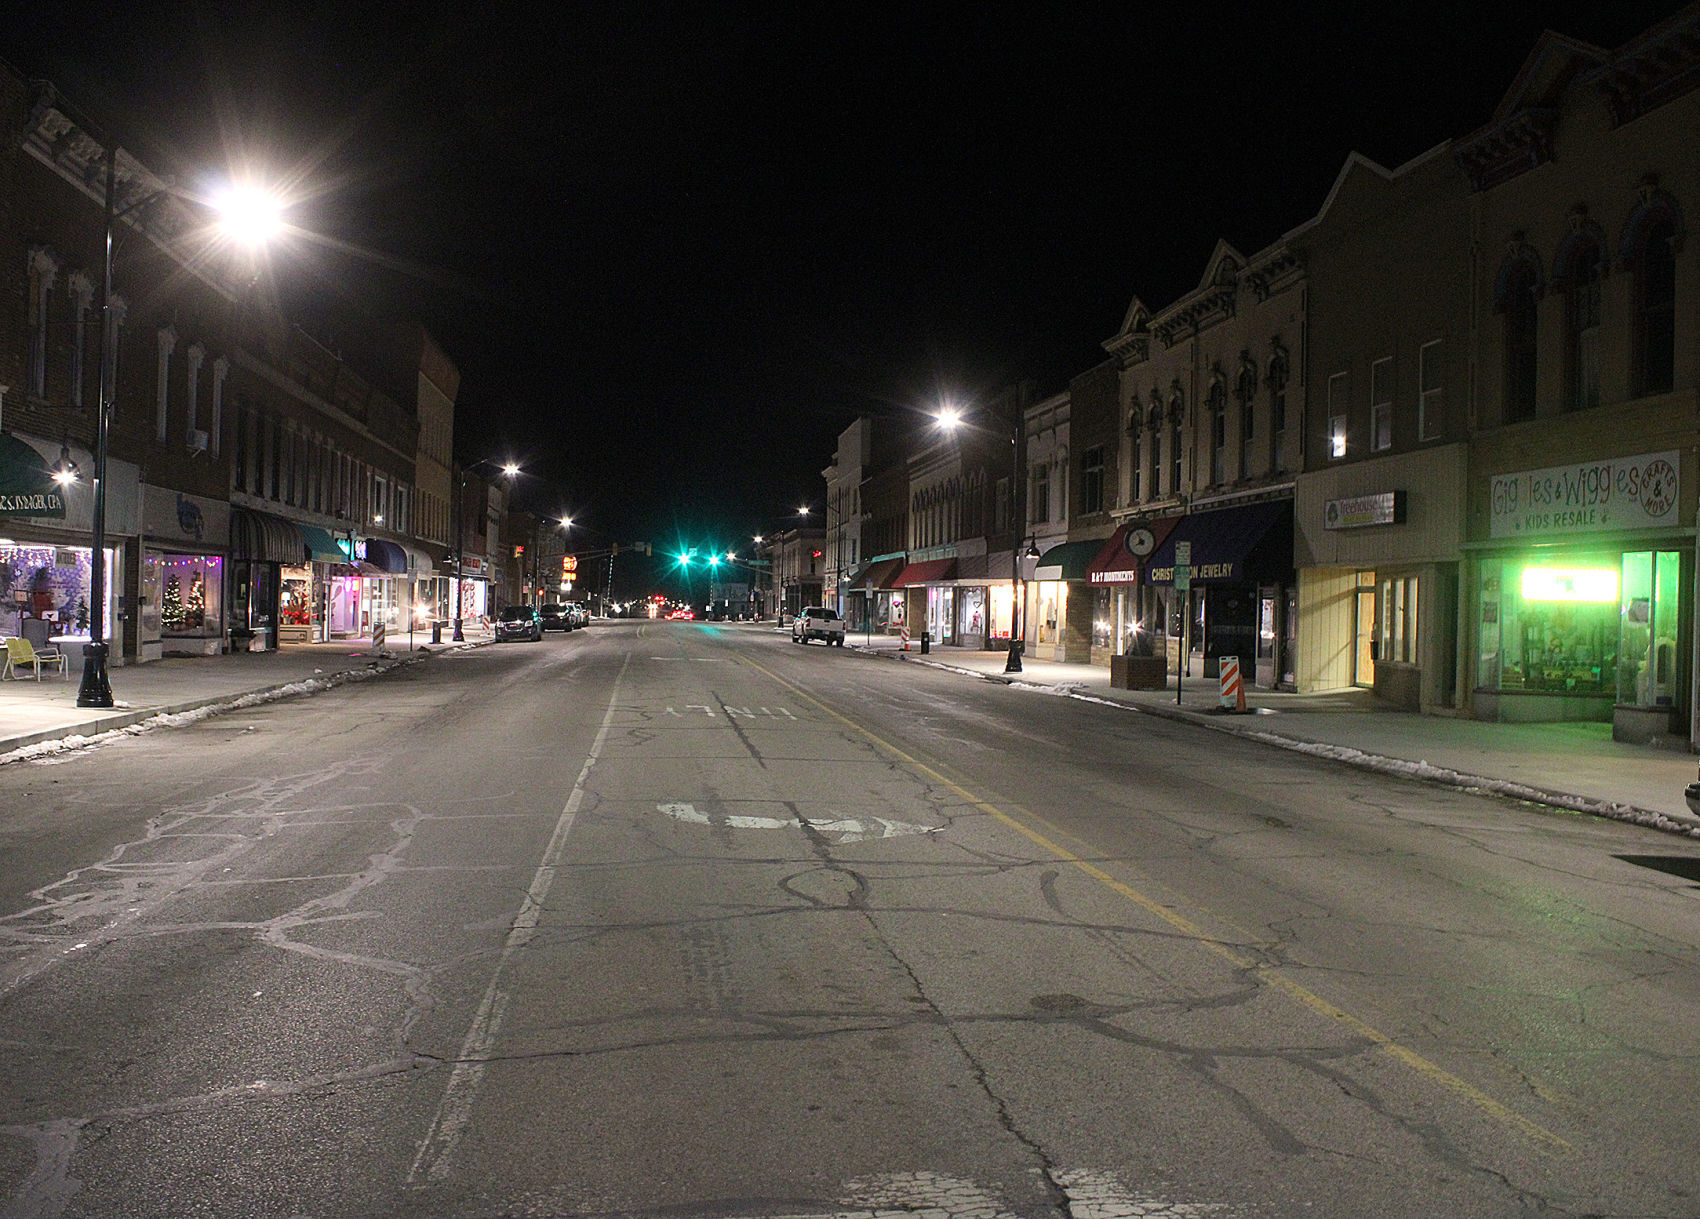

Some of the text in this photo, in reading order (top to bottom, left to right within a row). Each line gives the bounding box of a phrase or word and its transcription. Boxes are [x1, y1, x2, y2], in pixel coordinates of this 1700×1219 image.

[1643, 464, 1675, 489] CRAFTS
[1653, 480, 1662, 498] &
[1645, 495, 1673, 514] MORE
[1525, 509, 1596, 530] KIDS RESALE
[1152, 564, 1199, 581] CHRISTON
[1199, 562, 1233, 579] JEWELRY
